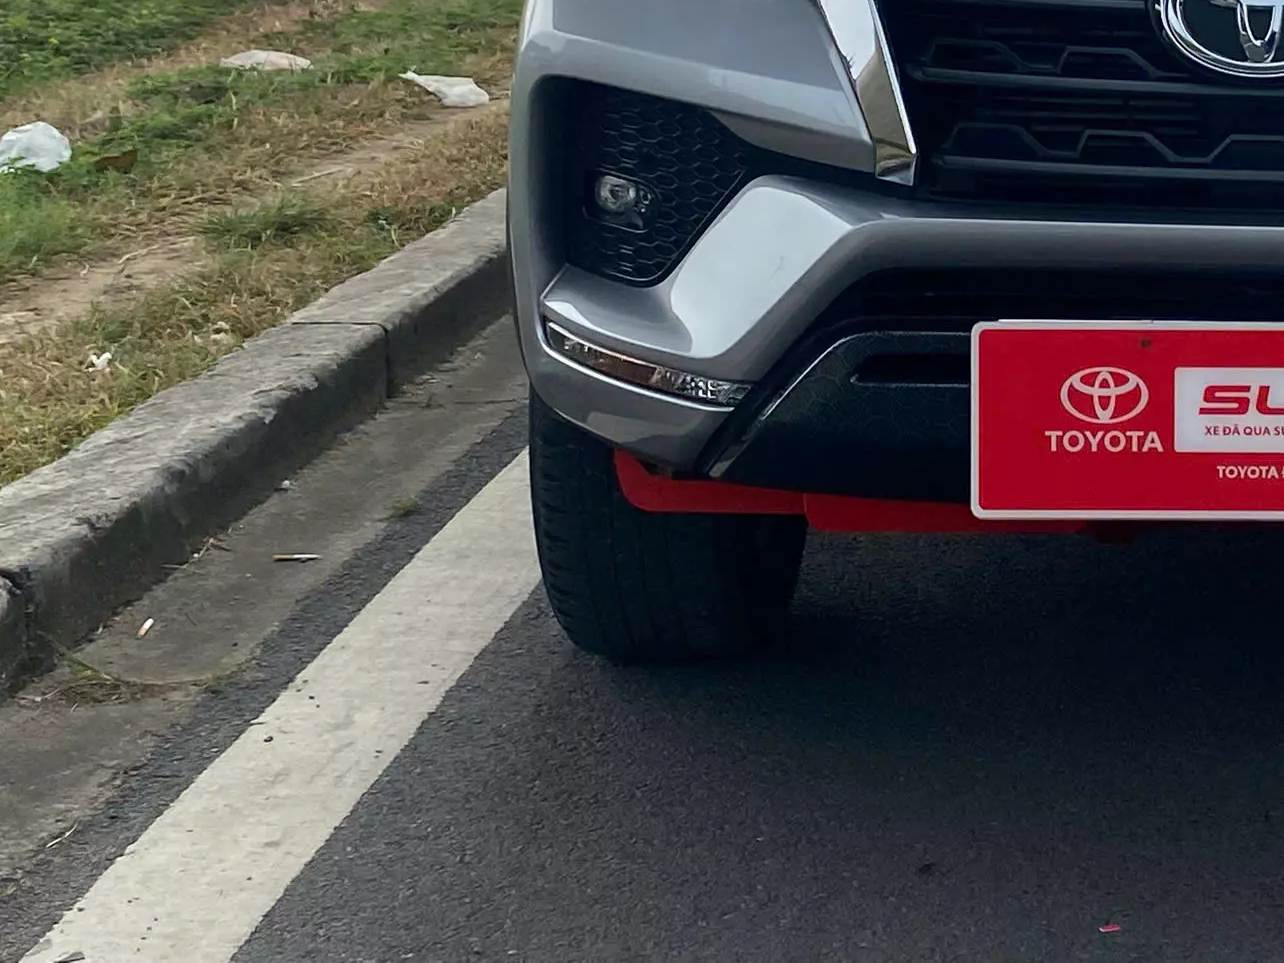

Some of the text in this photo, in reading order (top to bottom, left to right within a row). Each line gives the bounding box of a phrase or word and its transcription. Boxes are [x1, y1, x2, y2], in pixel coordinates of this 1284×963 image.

[1204, 425, 1219, 436] XE
[1222, 423, 1240, 436] ĐÃ
[1243, 425, 1271, 437] QUA
[1044, 430, 1164, 453] TOYOTA
[1217, 465, 1279, 479] TOYOTA
